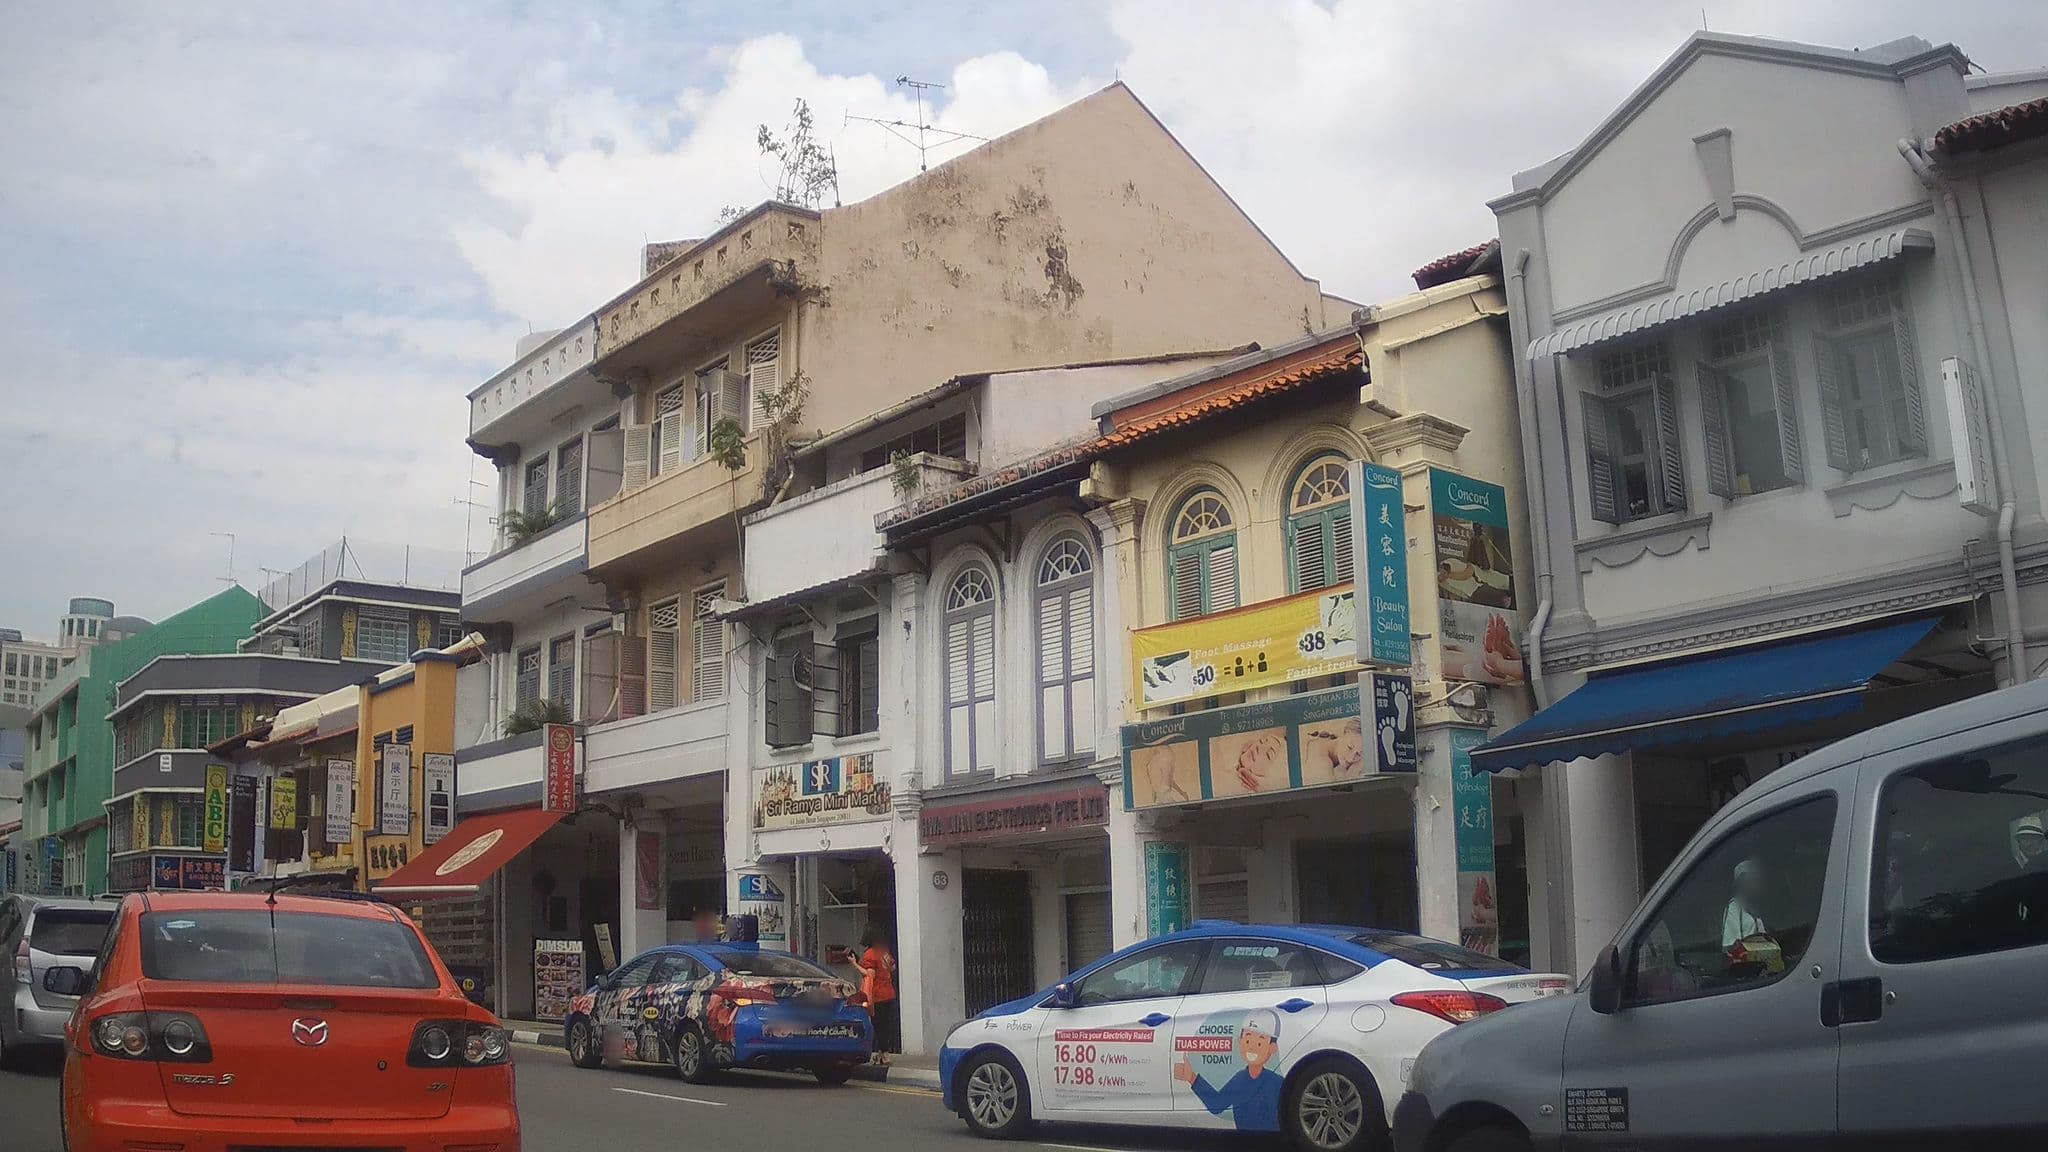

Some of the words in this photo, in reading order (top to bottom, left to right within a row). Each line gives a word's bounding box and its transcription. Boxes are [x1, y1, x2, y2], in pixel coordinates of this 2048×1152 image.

[1366, 468, 1398, 486] Concord
[1447, 483, 1490, 504] Concord
[1379, 503, 1396, 588] 美容院
[1373, 596, 1406, 619] Beauty
[1377, 617, 1403, 633] Salon
[1195, 645, 1219, 658] Foot
[1223, 636, 1272, 653] Massage
[1299, 631, 1325, 653] $38
[1193, 666, 1214, 686] $50
[1286, 665, 1322, 680] Facial
[1304, 705, 1344, 721] SINGAPORE
[1142, 717, 1185, 740] Concord
[390, 761, 401, 800] 展示厅
[207, 788, 224, 839] ABC
[767, 800, 782, 817] Sri
[784, 797, 821, 816] Ramya
[824, 793, 849, 810] Mini
[852, 790, 879, 808] Mart
[976, 802, 1051, 832] ELECTRONICS
[1055, 800, 1080, 822] PTE
[536, 939, 583, 951] DIMSUM
[1057, 1031, 1071, 1040] Time
[1072, 1032, 1079, 1040] to
[1080, 1031, 1088, 1040] Fix
[1089, 1033, 1102, 1041] your
[1102, 1031, 1132, 1041] Electricity
[1133, 1031, 1153, 1041] Rates!
[1199, 1025, 1234, 1034] CHOOSE
[1055, 1044, 1096, 1064] 16.80
[1176, 1039, 1198, 1049] TUAS
[1199, 1039, 1231, 1050] POWER
[1202, 1055, 1233, 1065] TODAY!
[218, 1073, 236, 1085] 3
[1054, 1066, 1094, 1086] 17.98
